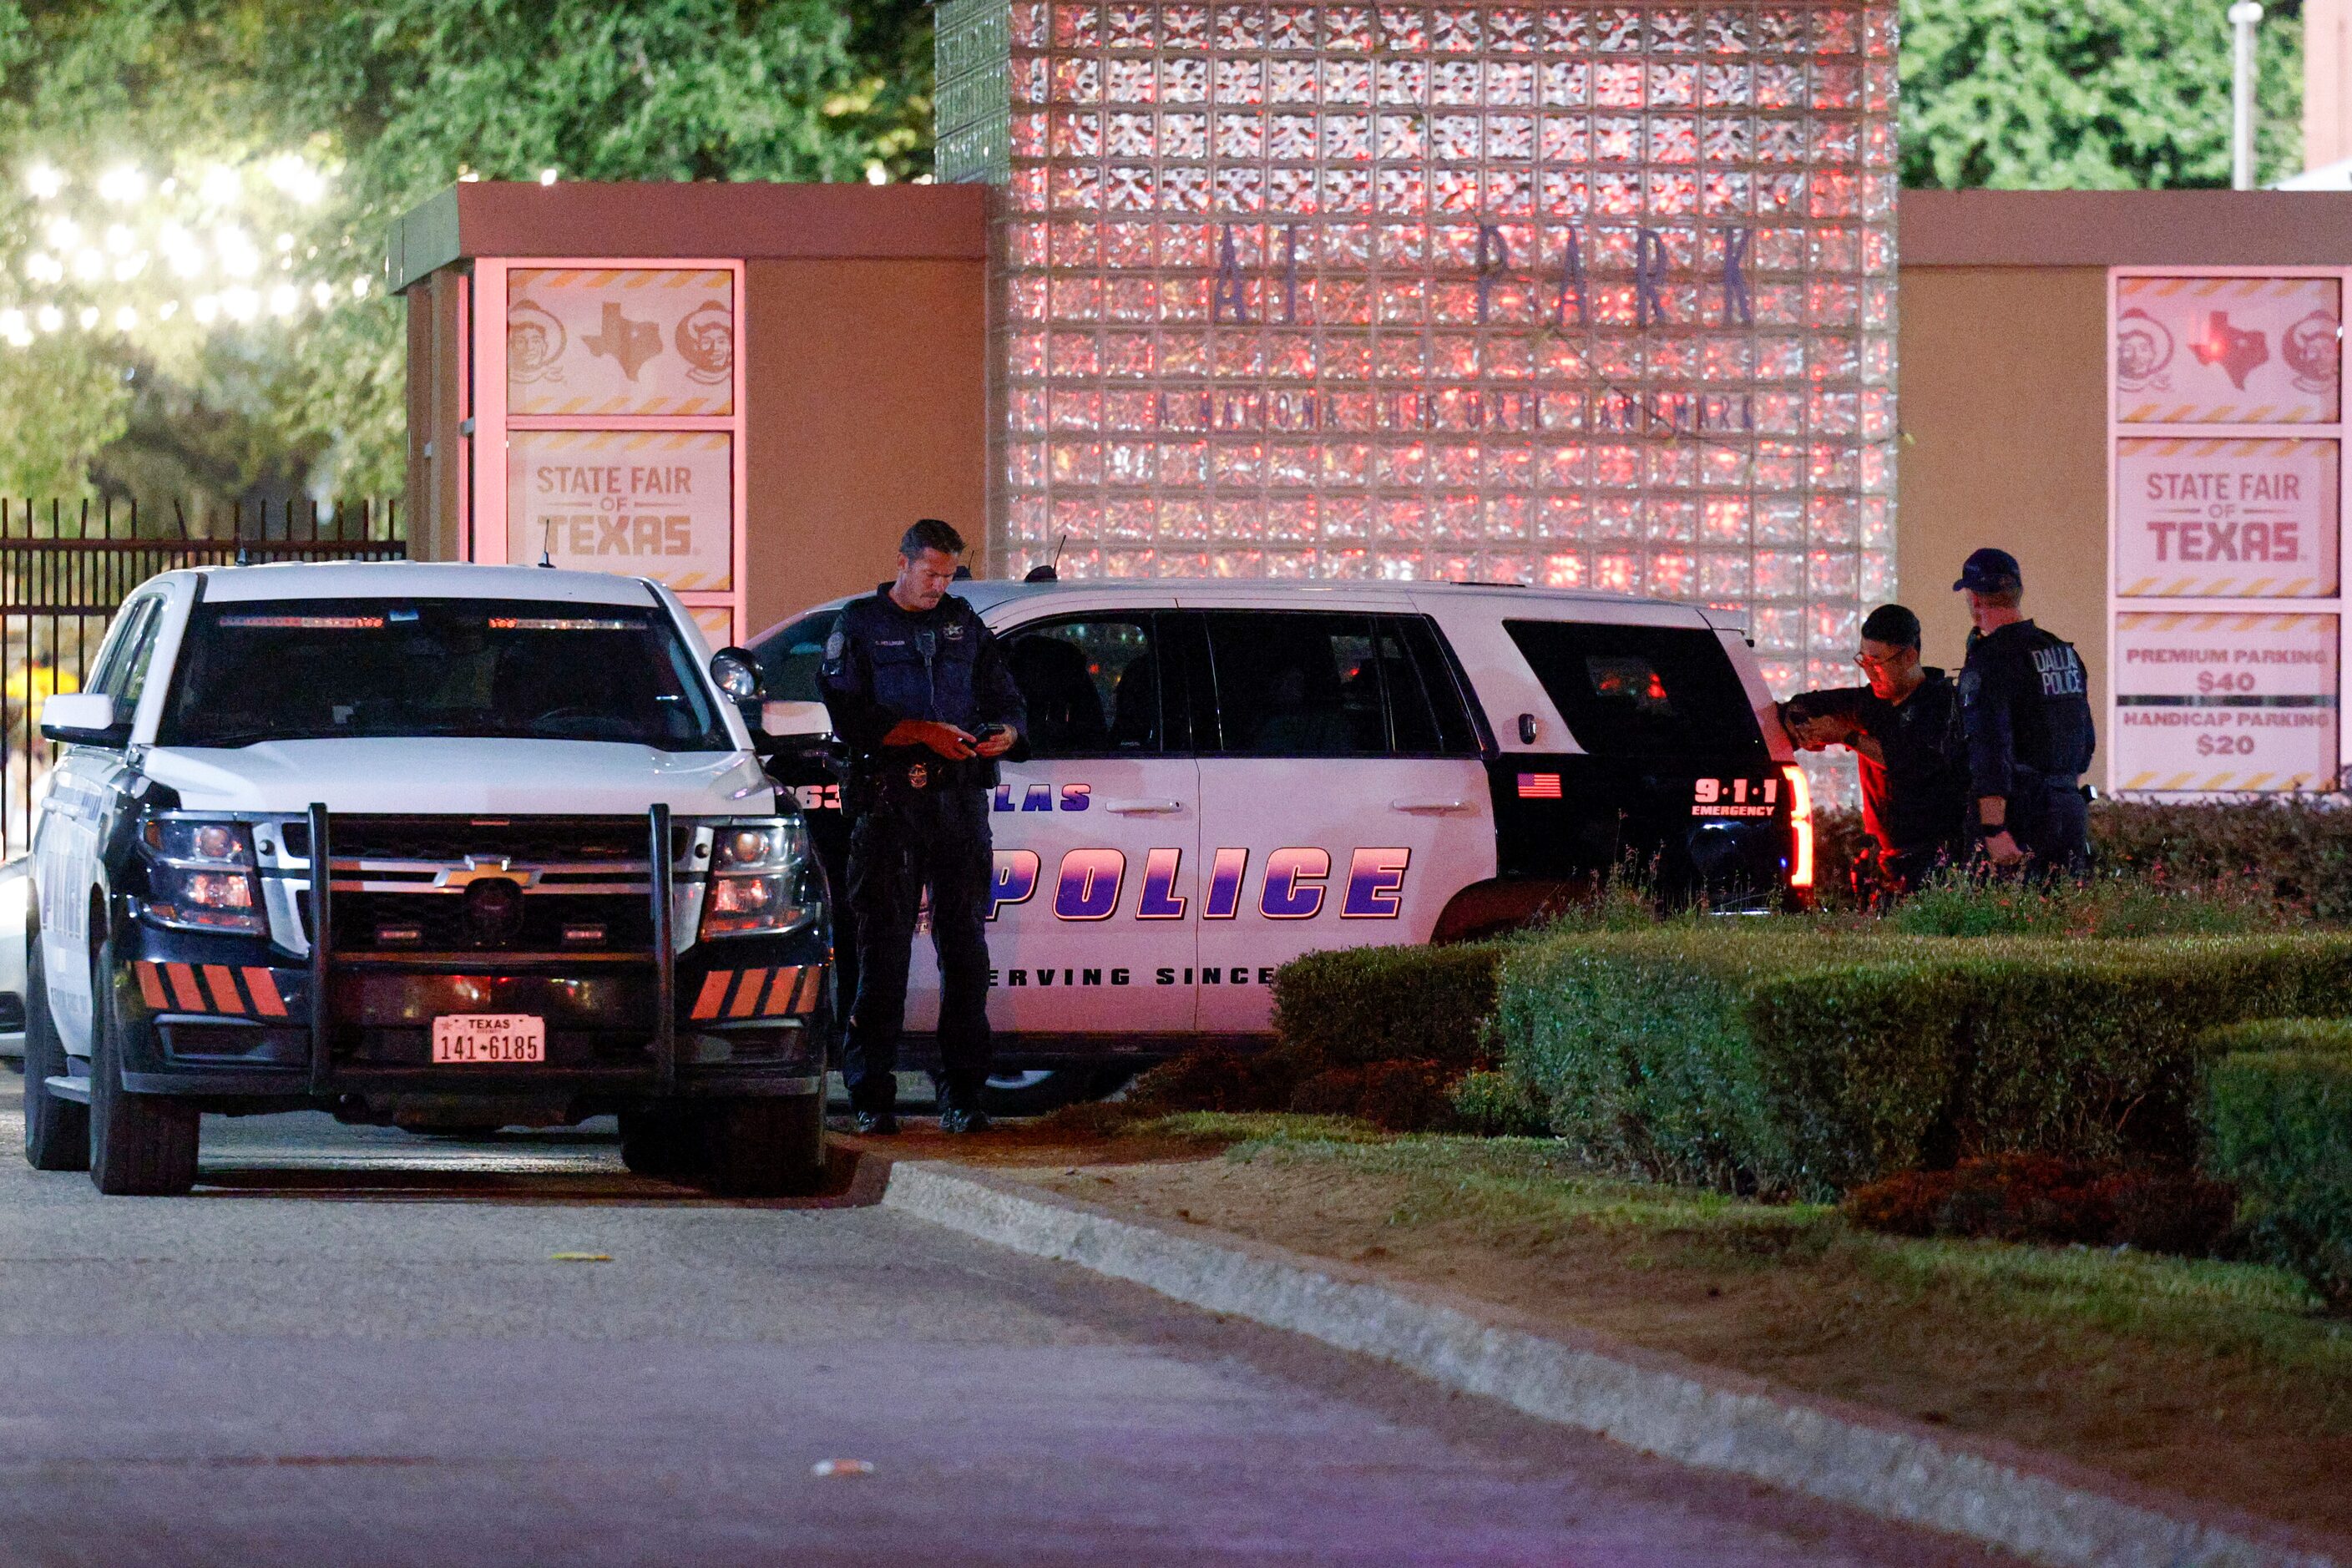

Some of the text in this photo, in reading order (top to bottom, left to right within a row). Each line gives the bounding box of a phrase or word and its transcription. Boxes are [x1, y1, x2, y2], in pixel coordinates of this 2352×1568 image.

[1477, 222, 1757, 328] PARK
[536, 466, 692, 494] STATE FAIR
[2146, 473, 2300, 500] STATE FAIR
[599, 496, 629, 512] OF
[2208, 503, 2236, 519] OF
[537, 514, 691, 555] TEXAS
[2146, 521, 2299, 562] TEXAS
[2031, 645, 2079, 673] DALLA
[2126, 648, 2328, 665] PREMIUM PARKING
[2041, 669, 2083, 695] POLICE
[2196, 670, 2256, 693] $40
[2122, 711, 2329, 728] HANDICAP PARKING
[2196, 732, 2256, 756] $20
[992, 783, 1092, 812] LAS
[1691, 805, 1776, 817] EMERGENCY
[985, 847, 1412, 922] POLICE
[989, 967, 1276, 987] ERVING SINCE
[468, 1019, 511, 1029] TEXAS
